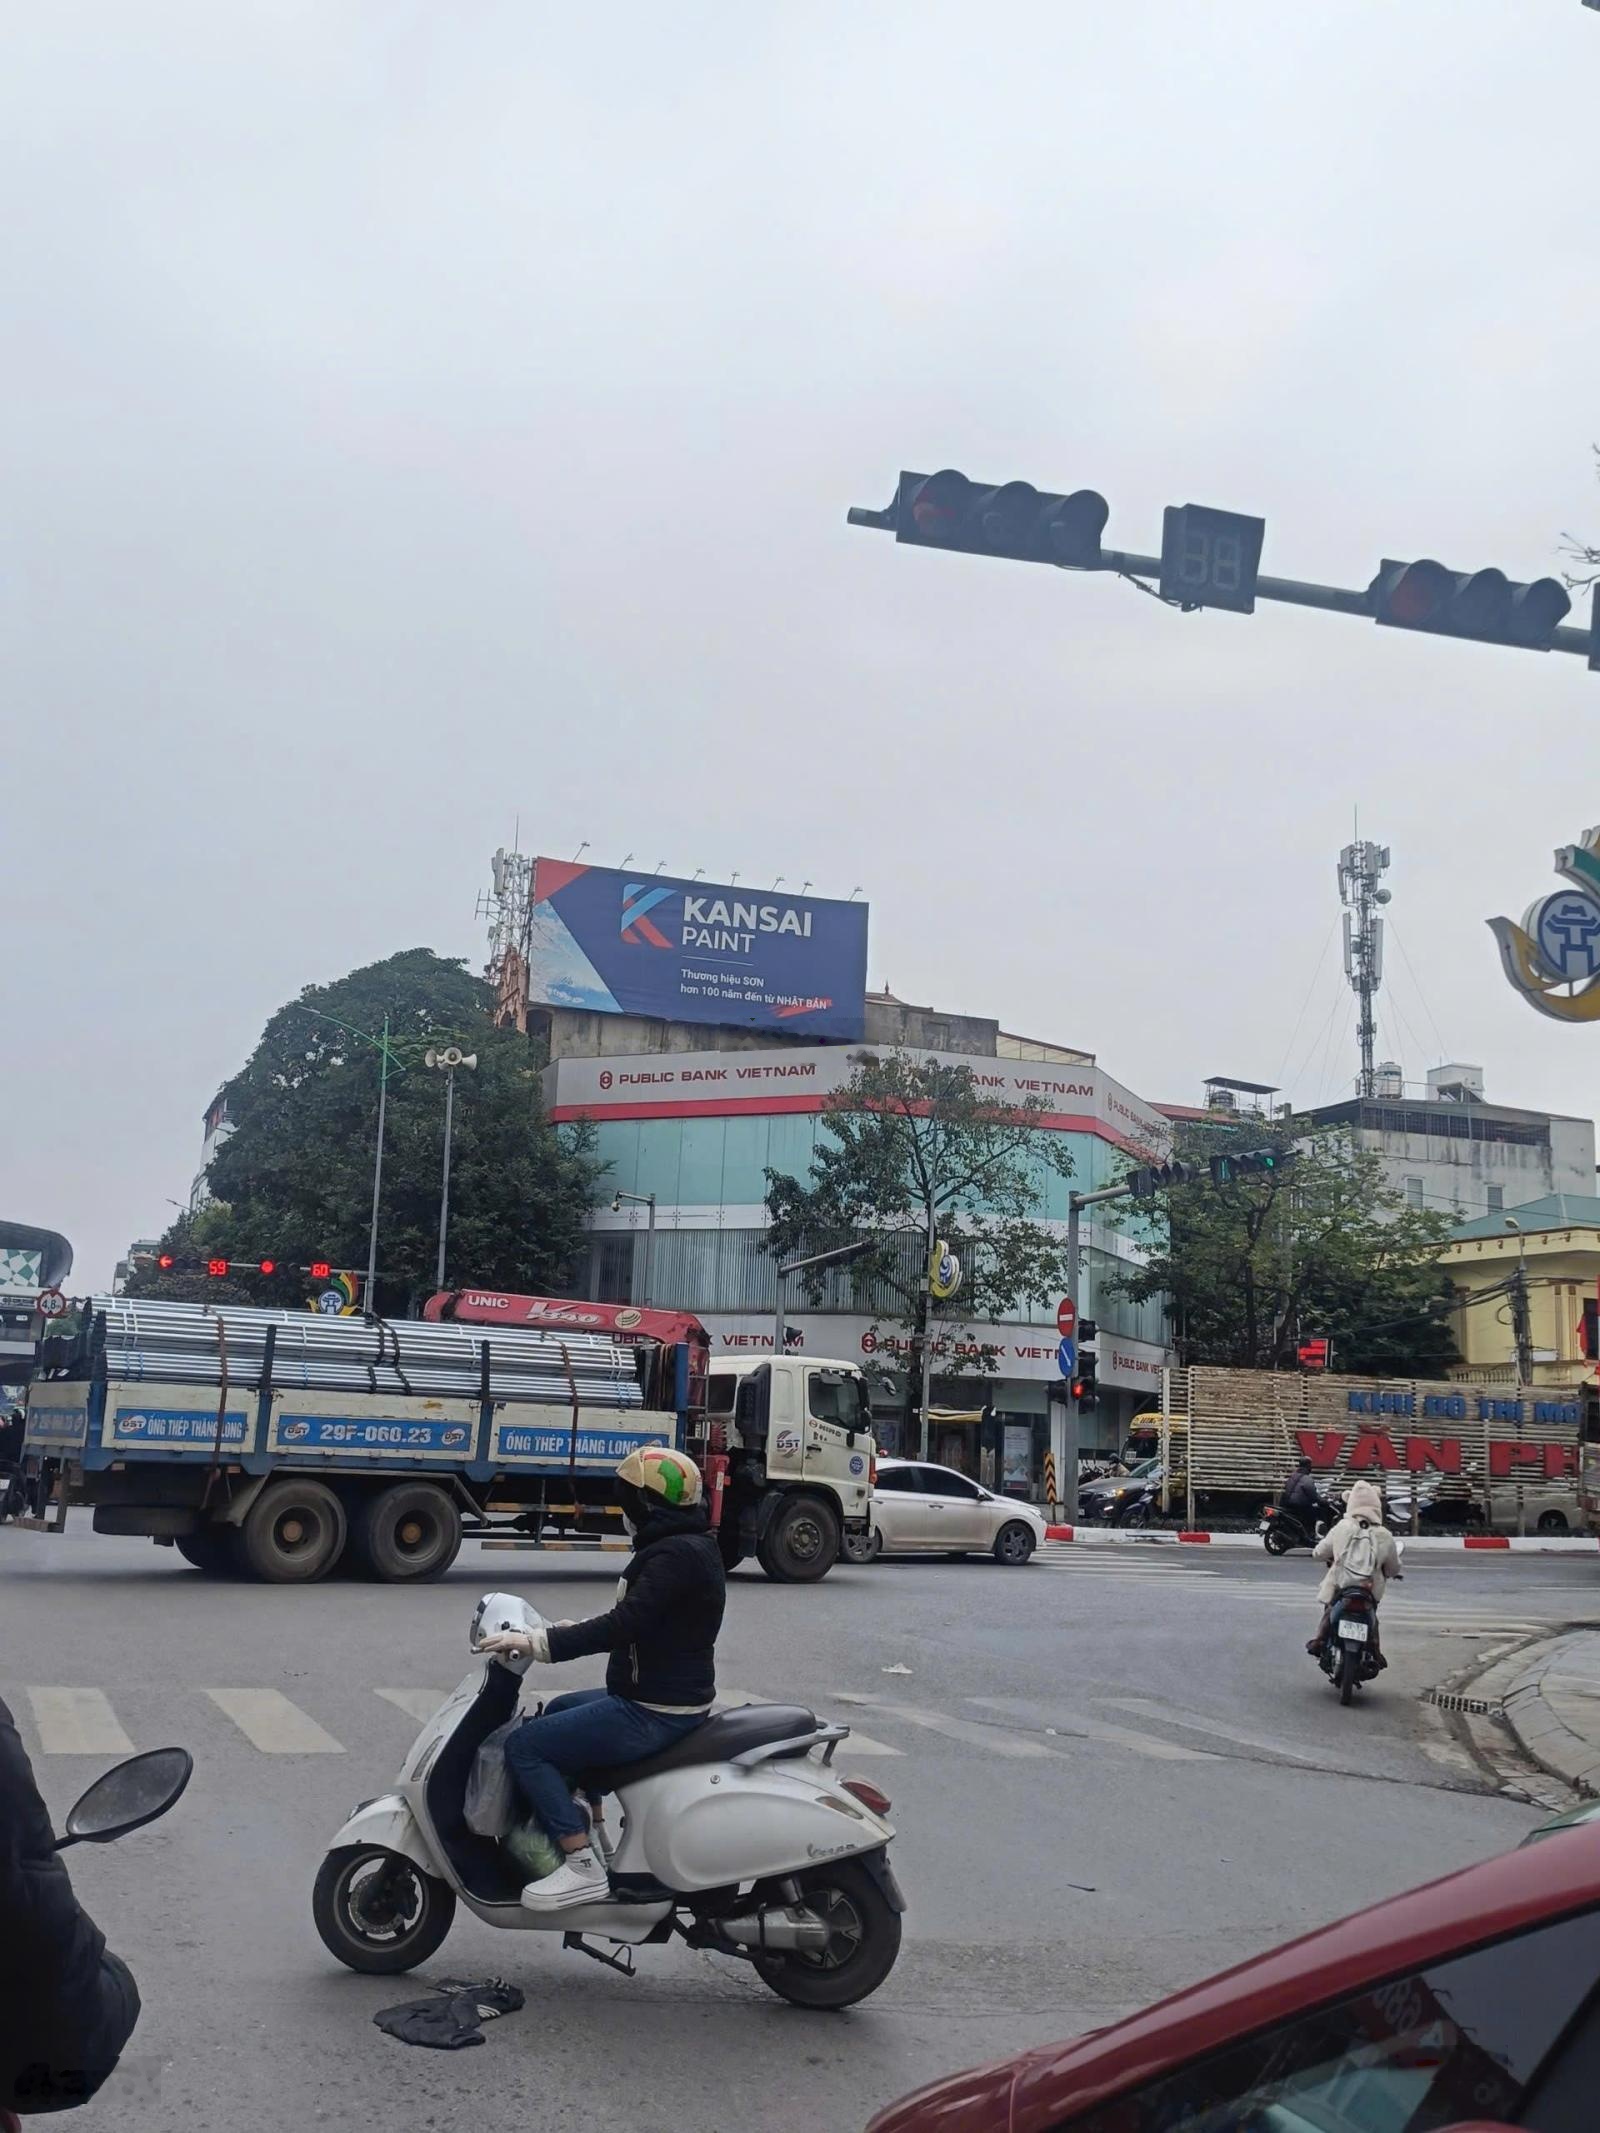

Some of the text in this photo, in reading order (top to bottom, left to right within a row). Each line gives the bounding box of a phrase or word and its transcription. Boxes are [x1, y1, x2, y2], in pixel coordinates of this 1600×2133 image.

[683, 896, 813, 937] KANSAI
[681, 926, 756, 953] PAINT
[680, 968, 765, 988] Thương hiệu SƠN
[680, 983, 699, 995] hơn
[701, 986, 720, 997] 100
[721, 988, 743, 999] năm
[744, 990, 763, 1003] đến
[764, 993, 776, 1004] từ
[776, 995, 804, 1009] NHẬT
[619, 1064, 816, 1085] PUBLIC BANK VIETNAM
[1013, 1078, 1094, 1097] VIETNAM
[312, 1263, 328, 1277] 60
[467, 1294, 510, 1309] UNIC
[147, 1414, 167, 1436] ỐNG
[168, 1416, 190, 1437] THÉP
[319, 1423, 433, 1445] 29F-060.23
[506, 1430, 532, 1451] ỐNG
[534, 1434, 563, 1453] THÉP
[776, 1439, 800, 1449] DST
